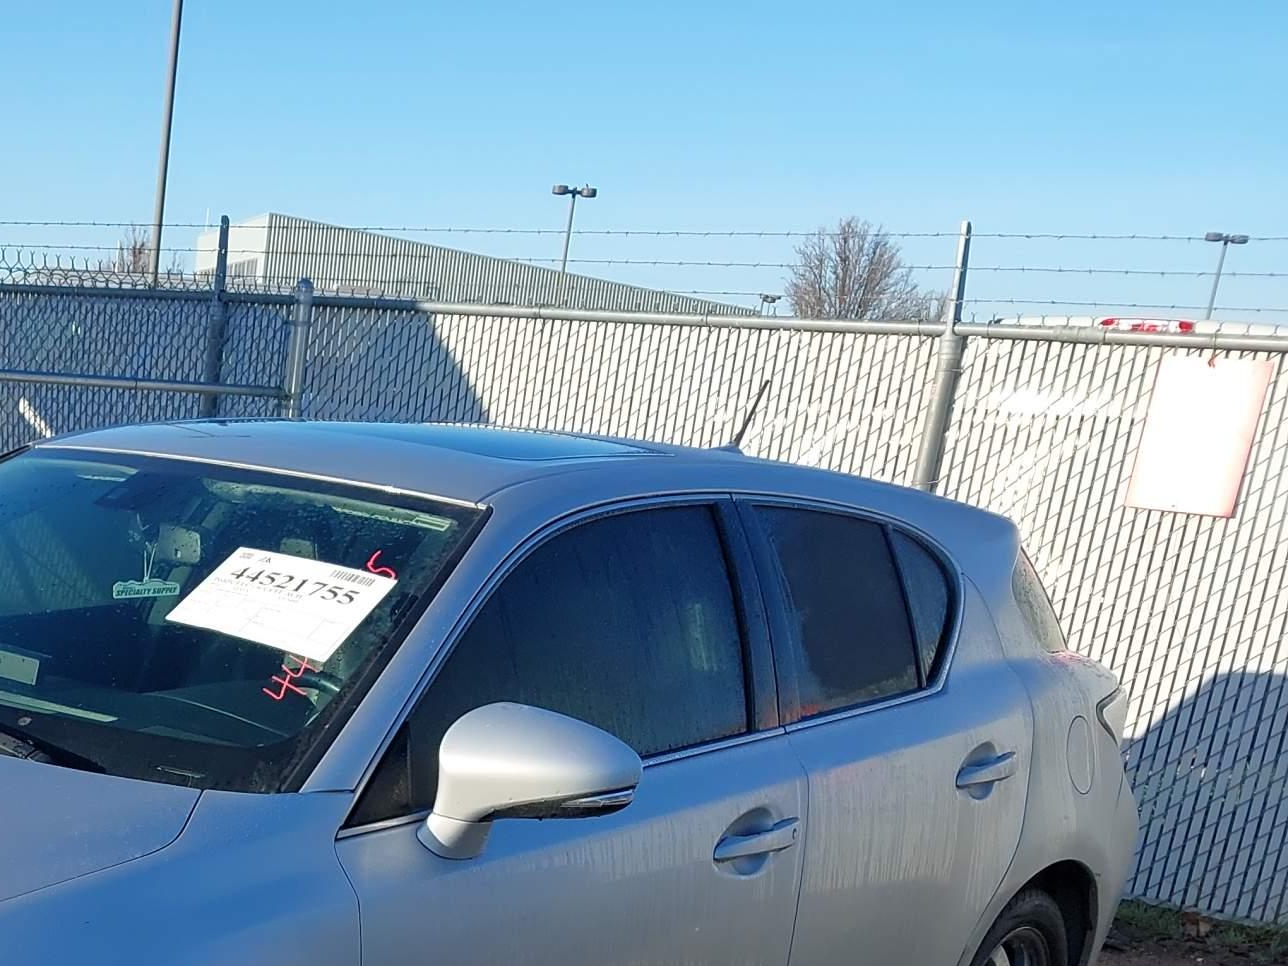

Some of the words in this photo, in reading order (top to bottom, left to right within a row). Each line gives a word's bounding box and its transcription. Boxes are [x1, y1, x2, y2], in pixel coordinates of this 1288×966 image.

[115, 588, 152, 597] SPECIALTY
[152, 586, 177, 594] SUPPLY
[231, 566, 361, 605] 44521755
